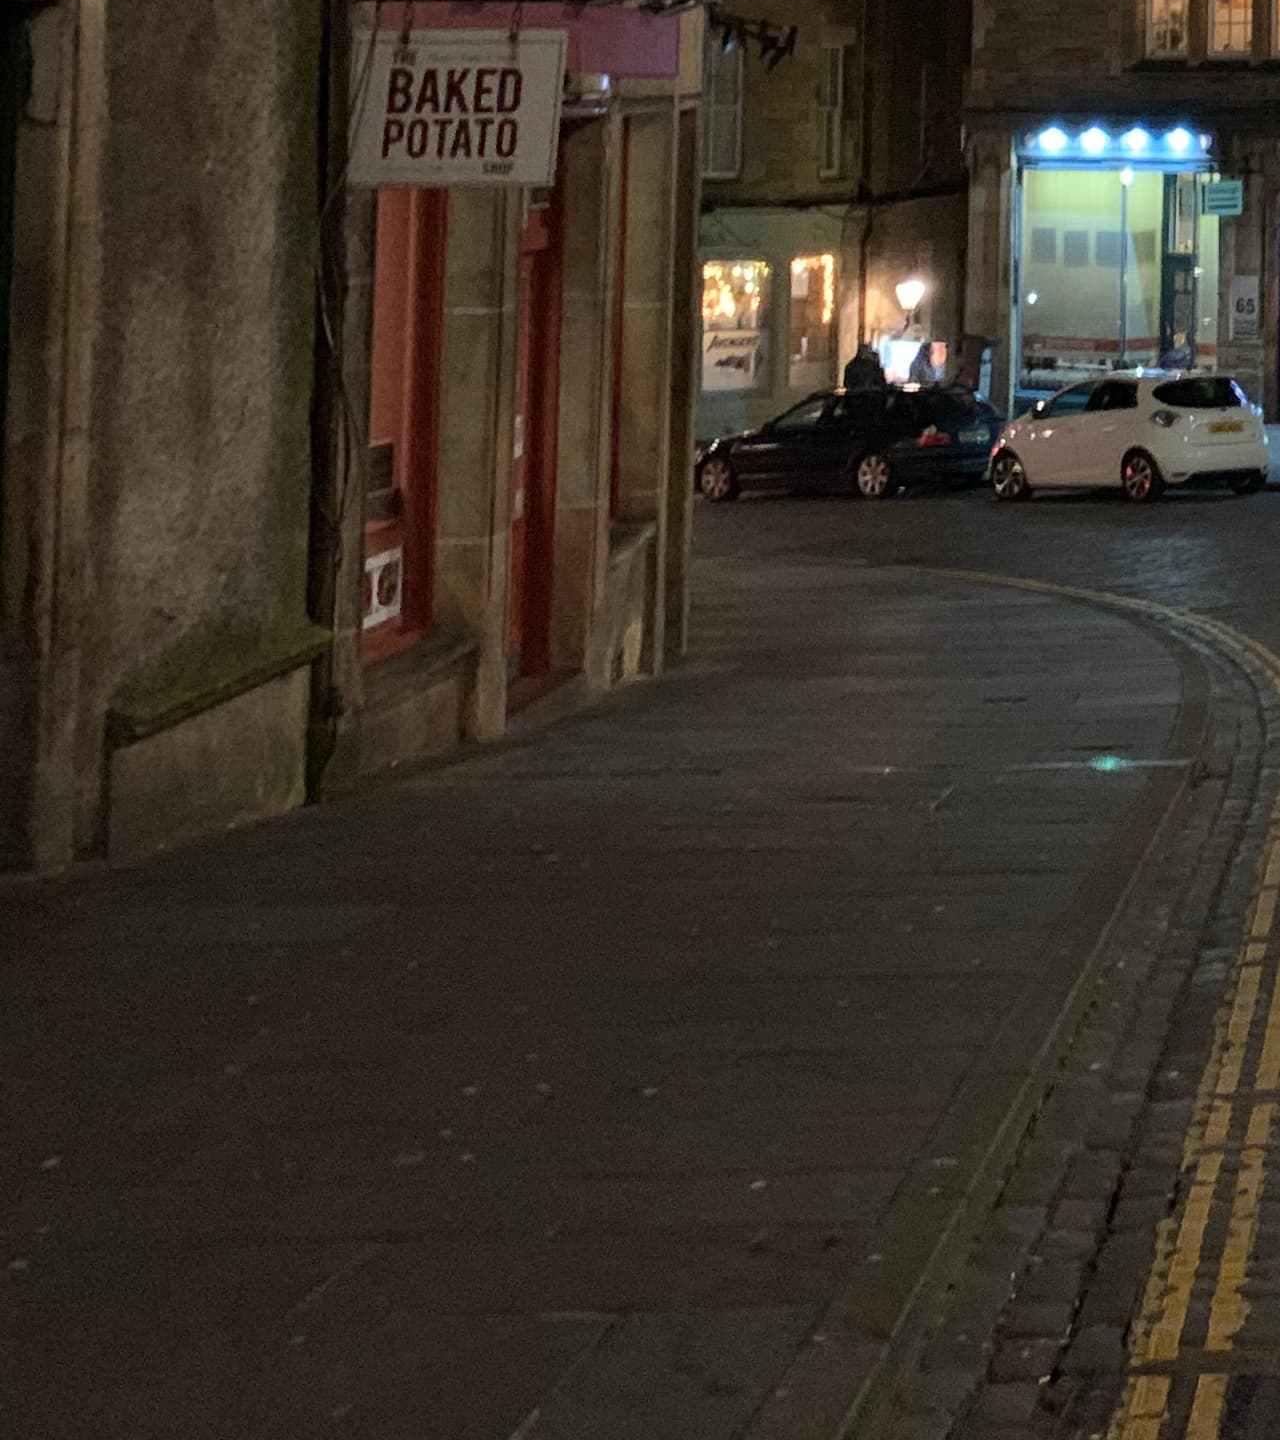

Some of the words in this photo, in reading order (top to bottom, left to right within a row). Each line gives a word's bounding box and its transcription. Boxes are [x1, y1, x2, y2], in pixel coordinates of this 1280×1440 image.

[387, 68, 522, 113] BAKED
[382, 118, 517, 159] POTATO
[1236, 297, 1256, 314] 65
